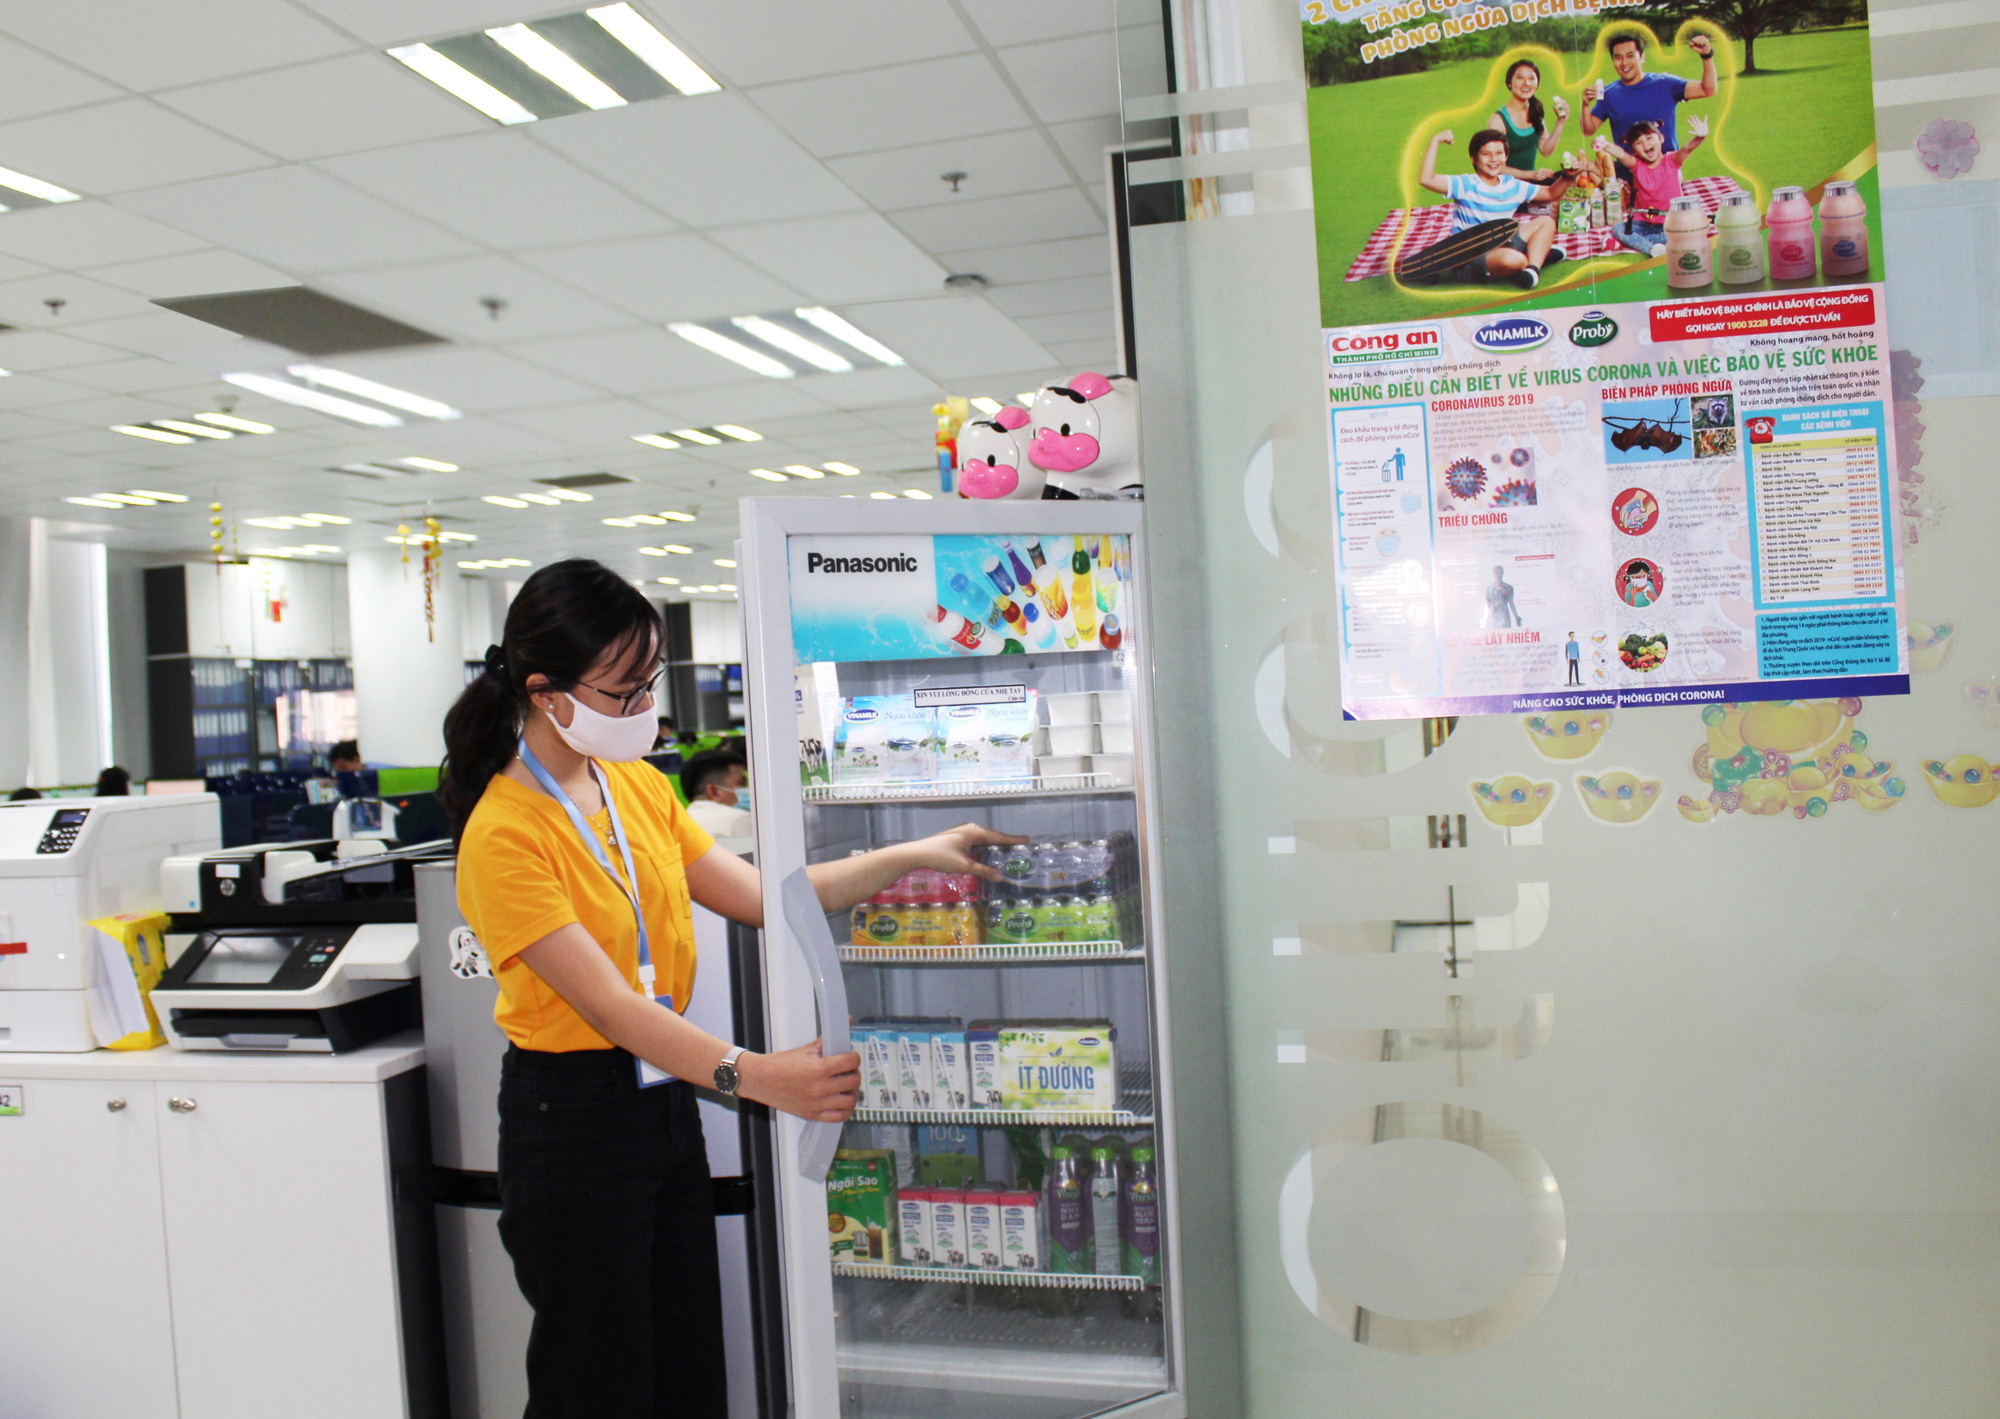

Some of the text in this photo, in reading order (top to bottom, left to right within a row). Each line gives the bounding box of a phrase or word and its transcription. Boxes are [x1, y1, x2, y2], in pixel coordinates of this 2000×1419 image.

[1306, 1, 1327, 24] 2
[1361, 1, 1425, 33] TĂNG
[1361, 0, 1567, 64] PHÒNG NGỪA DỊCH
[1657, 309, 1673, 319] HÃY
[1675, 307, 1692, 318] BIẾT
[1694, 306, 1712, 316] BẢO
[1712, 305, 1723, 316] VỆ
[1724, 305, 1742, 315] BẠN
[1744, 302, 1771, 312] CHÍNH
[1773, 301, 1784, 310] LÀ
[1785, 299, 1803, 309] BẢO
[1803, 297, 1815, 309] VỆ
[1816, 296, 1840, 308] CỘNG
[1479, 325, 1545, 342] VINAMILK
[1572, 323, 1613, 341] Proby
[1686, 324, 1701, 334] GỌI
[1702, 322, 1725, 332] NGAY
[1727, 321, 1747, 330] 1900
[1748, 319, 1768, 328] 3228
[1783, 315, 1810, 326] ĐƯỢC
[1332, 330, 1438, 351] Công an
[1750, 330, 1874, 347] Không hoang mang, hốt hoảng
[1328, 359, 1501, 380] Không lơ là, chủ quan trong phòng chống dịch
[1329, 340, 1878, 402] NHỮNG ĐIỀU CẦN BIẾT VỀ VIRUS CORONA VÀ VIỆC BẢO VỆ SỨC KHỎE
[1602, 378, 1732, 402] BIỆN PHÁP PHÒNG NGỪA
[1431, 393, 1534, 412] CORONAVIRUS 2019
[1439, 511, 1508, 529] TRIỆU CHỨNG
[808, 552, 917, 573] Panasonic
[1485, 631, 1502, 645] LÂY
[1507, 628, 1540, 643] NHIỄM
[1513, 690, 1724, 709] NÂNG CAO SỨC KHỎE, PHÒNG DỊCH CORONA!
[1018, 1061, 1094, 1090] ÍT ĐƯỜNG
[828, 1176, 854, 1192] Ngôi
[857, 1175, 878, 1186] Sao
